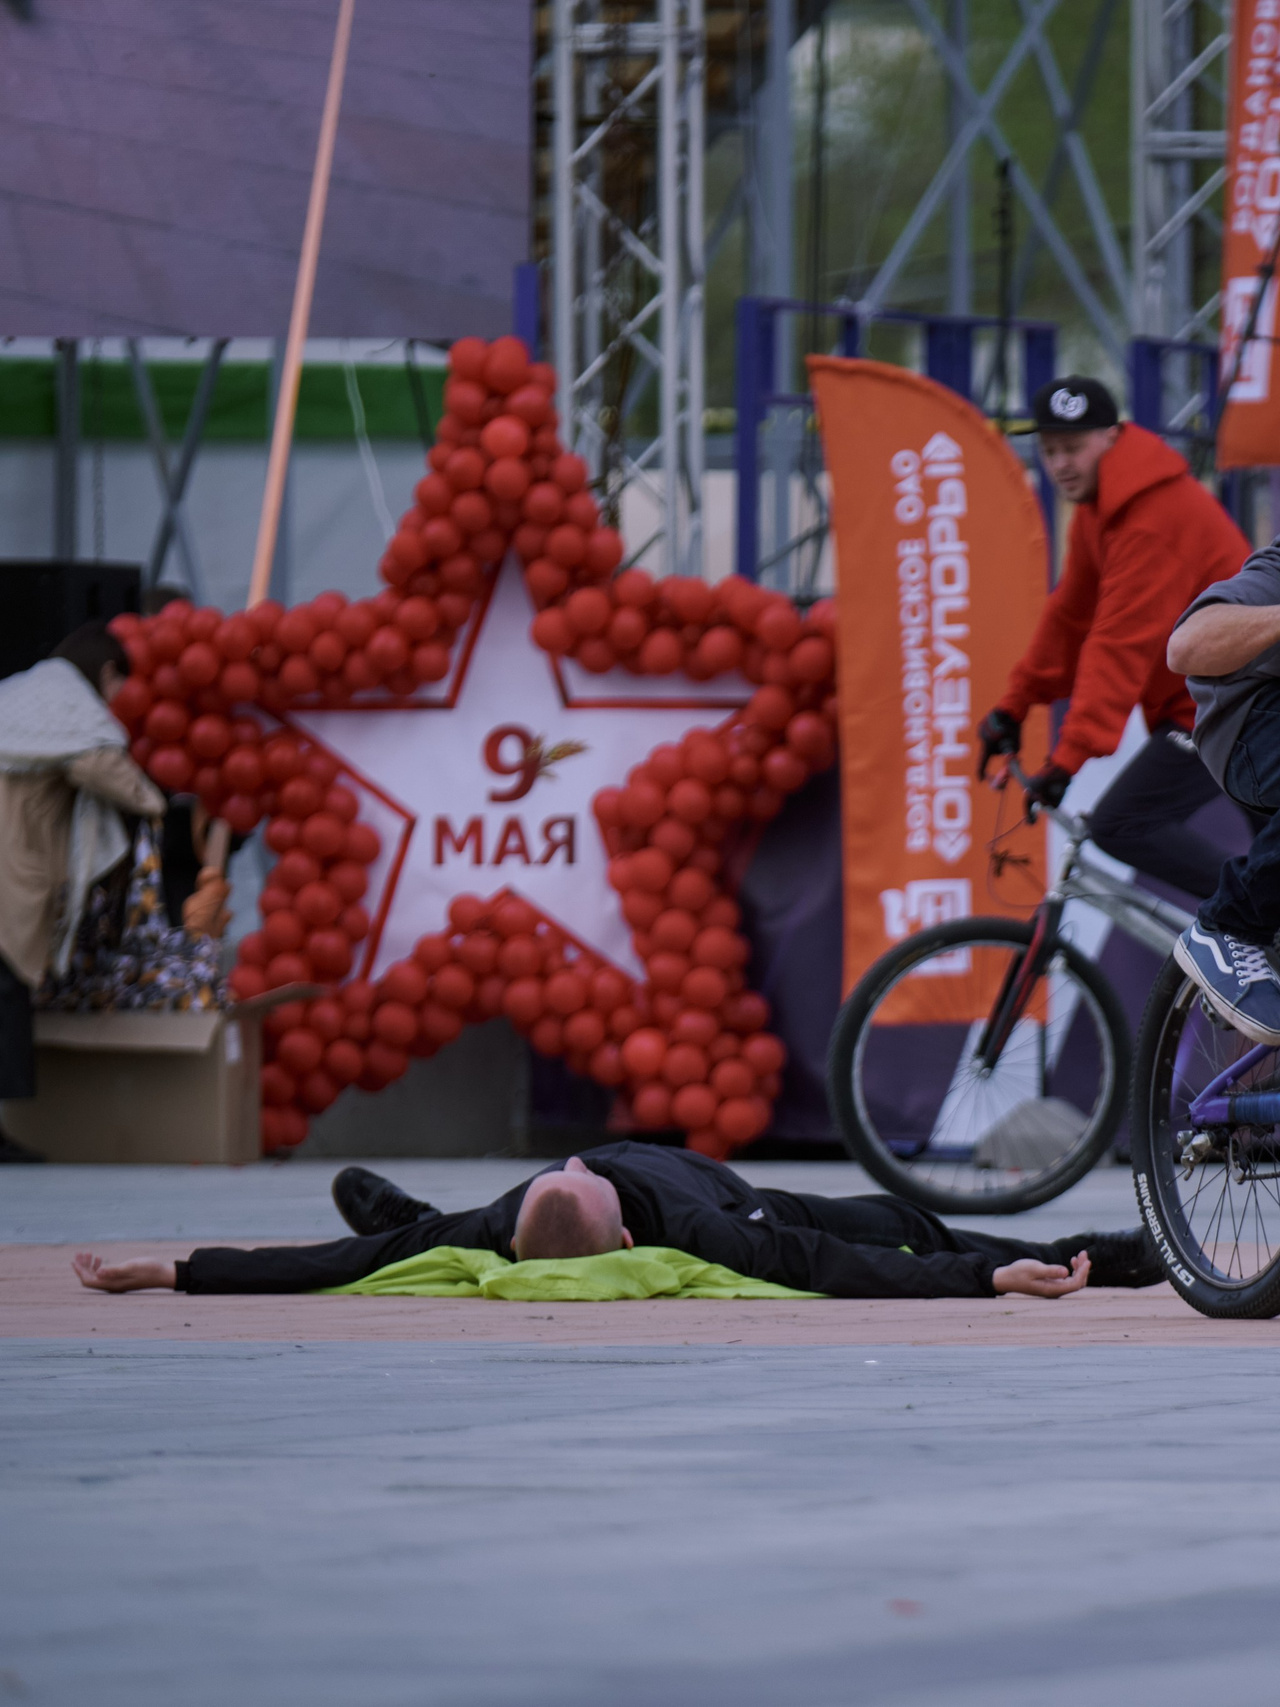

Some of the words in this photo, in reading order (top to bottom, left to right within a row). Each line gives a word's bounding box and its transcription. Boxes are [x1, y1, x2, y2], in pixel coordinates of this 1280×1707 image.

[890, 448, 925, 525] ОАО
[898, 538, 931, 851] БОГДАНОВИЧСКОЕ
[483, 724, 542, 803] 9
[433, 814, 576, 867] МАЯ
[1137, 1172, 1165, 1244] TERRAINS
[1159, 1239, 1178, 1265] ALL
[1171, 1263, 1196, 1287] CST
